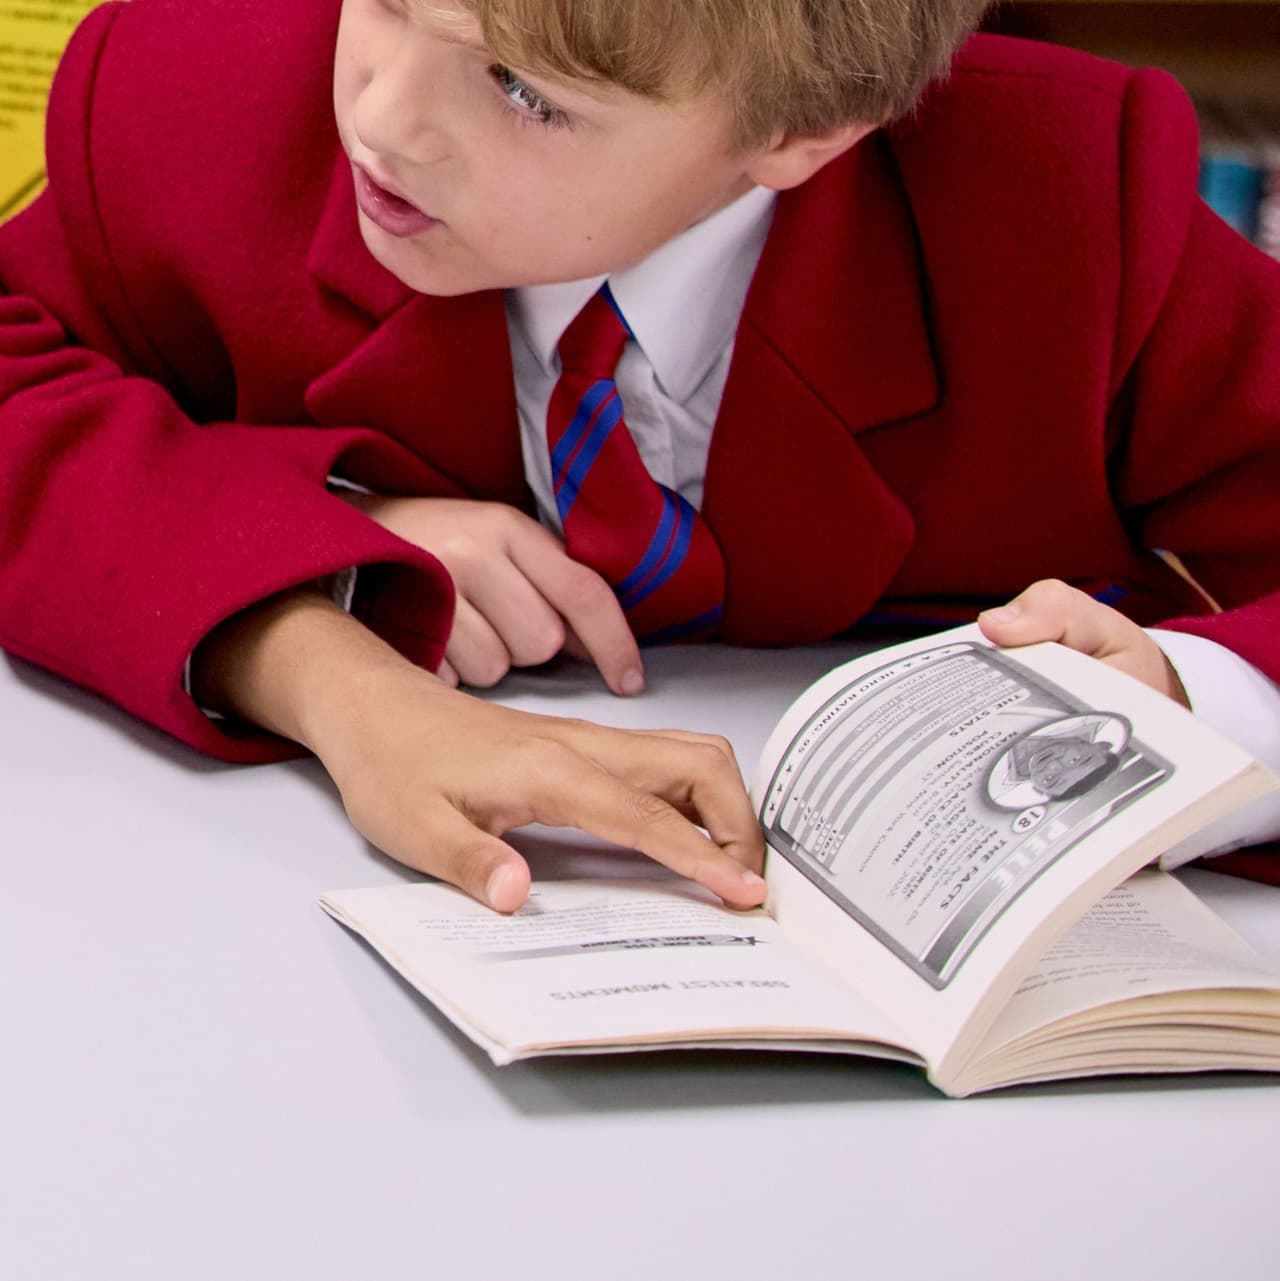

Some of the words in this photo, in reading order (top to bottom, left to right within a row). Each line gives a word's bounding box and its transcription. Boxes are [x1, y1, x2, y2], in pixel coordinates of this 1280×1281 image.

[859, 669, 895, 694] HERO
[814, 693, 857, 732] RATING:
[997, 694, 1021, 709] THE
[949, 710, 991, 738] STATS
[933, 729, 989, 771] POSITION:
[962, 731, 1002, 760] CLUBS:
[939, 780, 973, 811] PLACE
[924, 813, 937, 827] OF
[941, 805, 968, 830] AGE:
[1017, 808, 1040, 830] 18
[950, 815, 977, 846] DATE
[891, 829, 922, 866] BIRTH:
[934, 847, 948, 862] OF
[982, 839, 1008, 864] THE
[901, 864, 936, 899] BIRTH:
[940, 866, 980, 910] FACTS
[581, 939, 629, 949] SWEDEN
[549, 983, 671, 1000] MOMENTS
[679, 980, 790, 993] GREATEST
